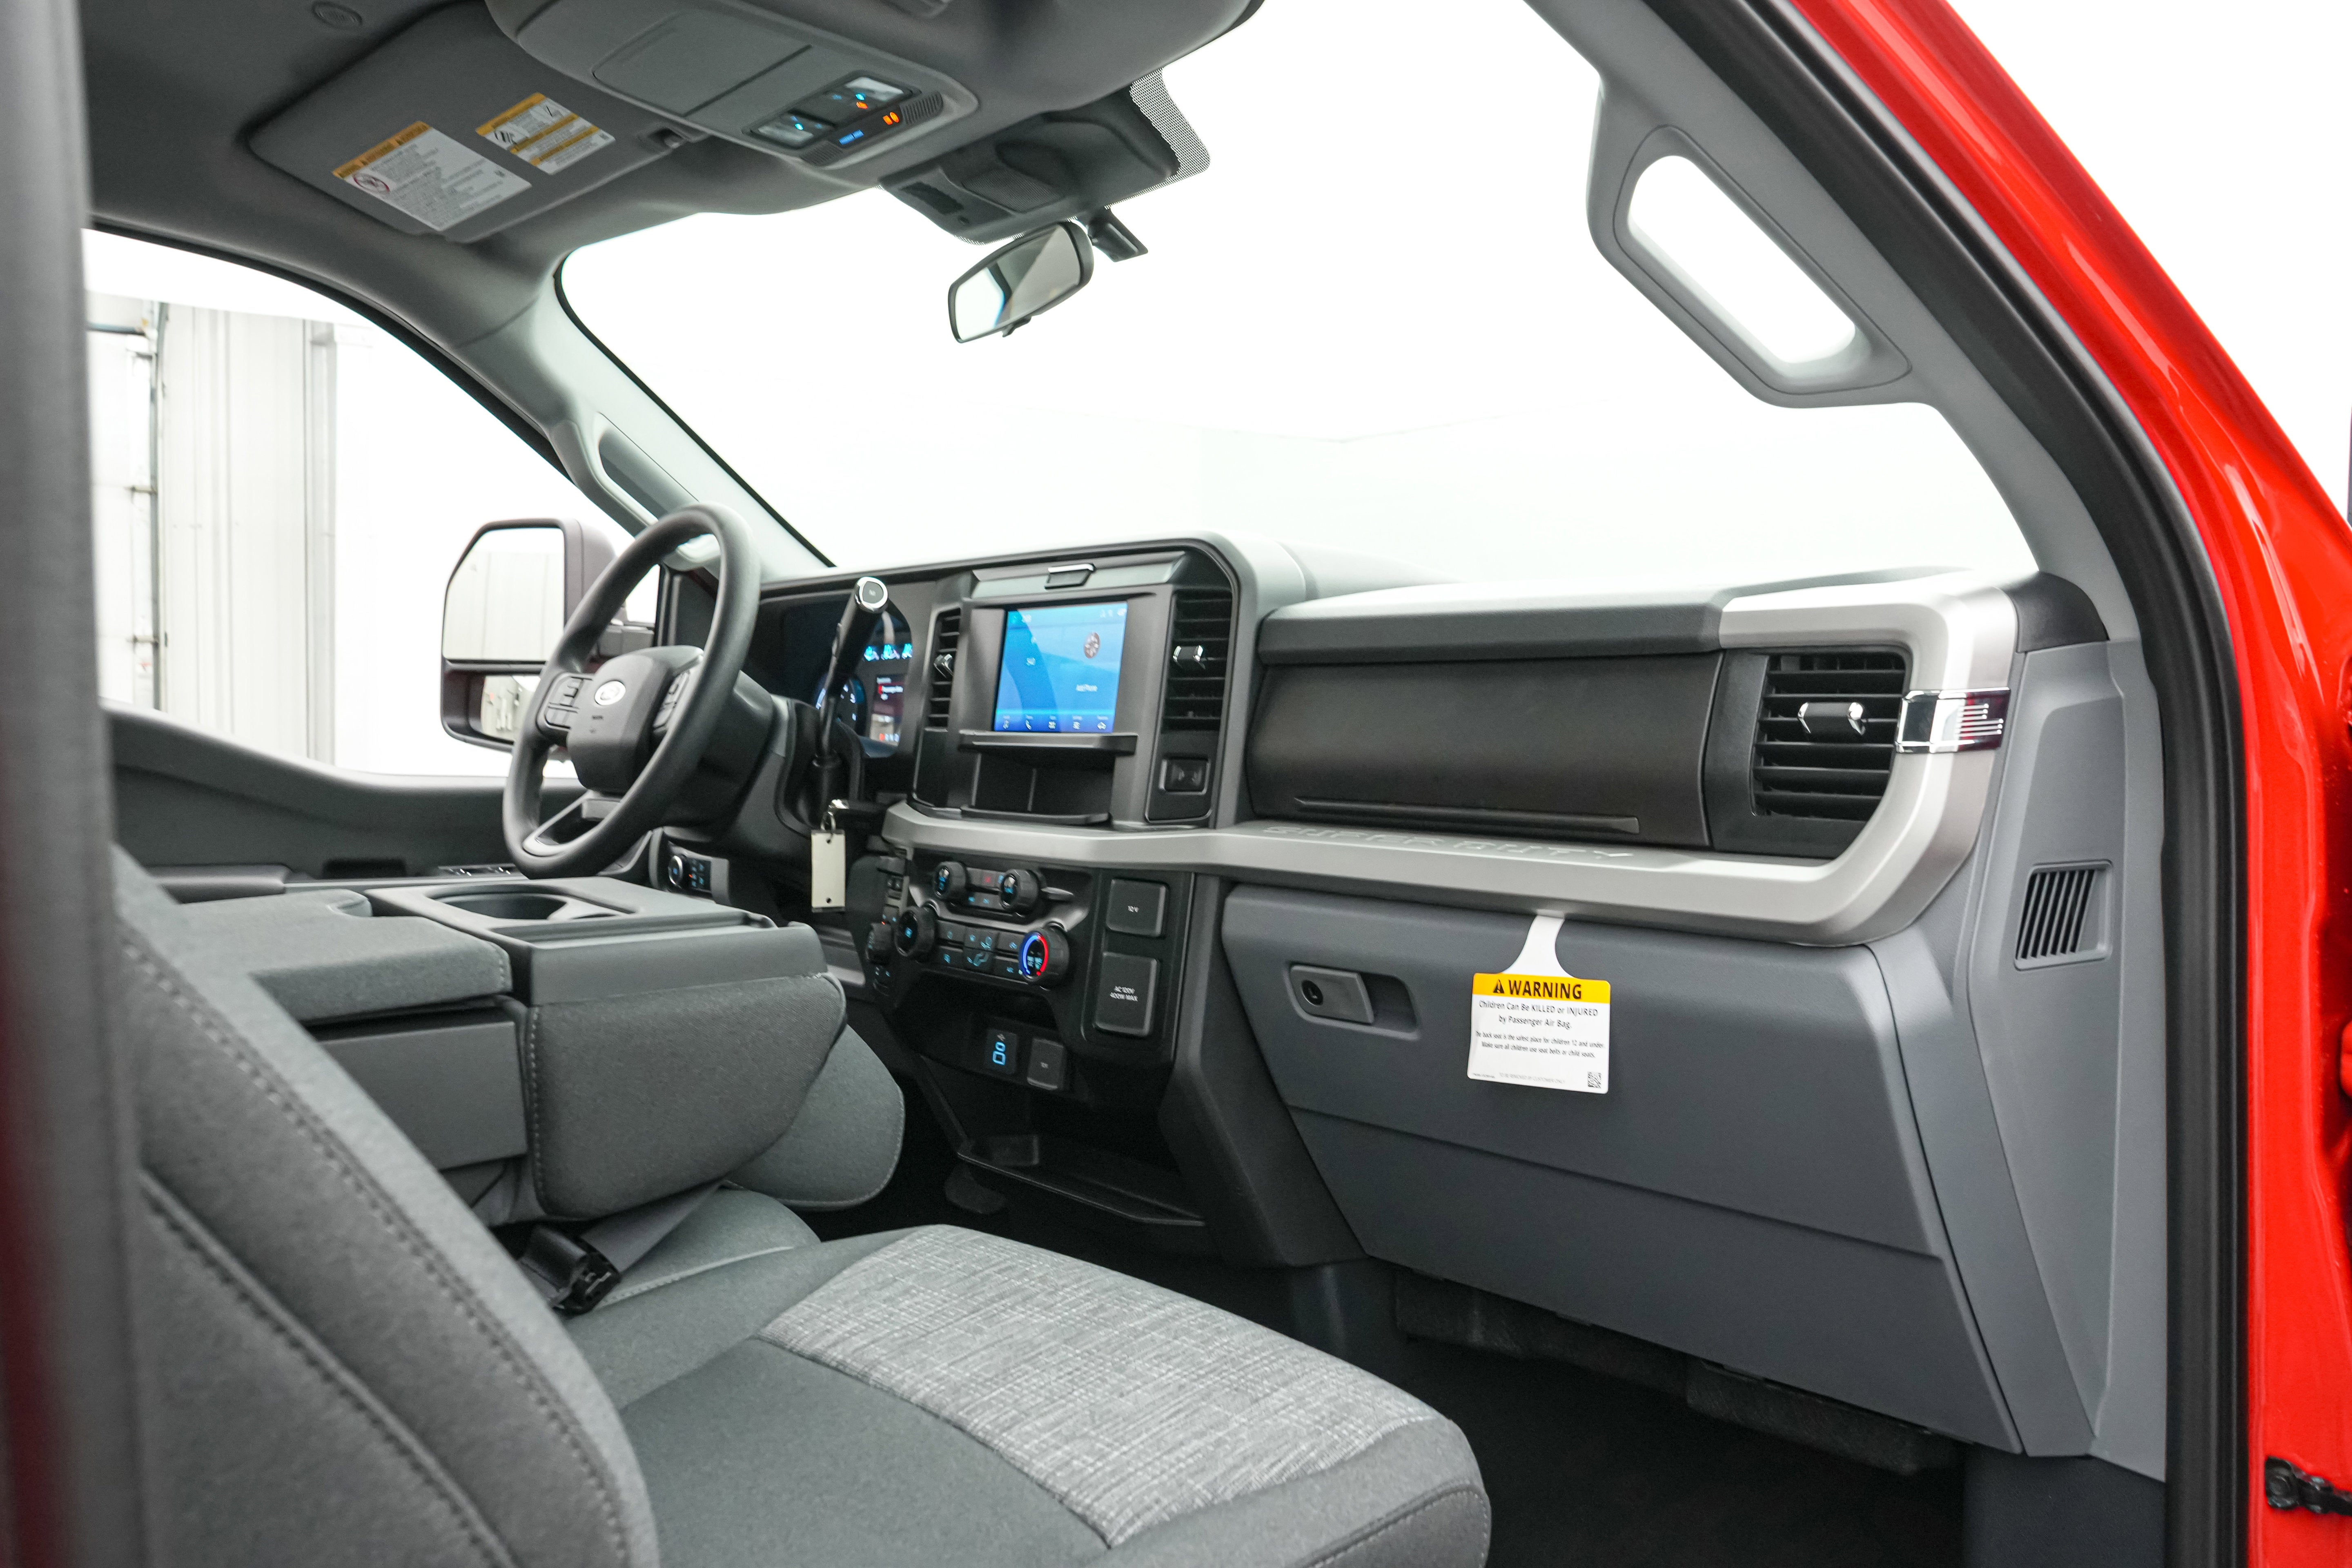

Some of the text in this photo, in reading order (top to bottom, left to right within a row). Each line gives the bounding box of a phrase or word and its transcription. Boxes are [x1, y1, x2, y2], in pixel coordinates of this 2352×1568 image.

[1508, 979, 1582, 1000] WARNING
[1479, 1000, 1505, 1009] Children
[1506, 1002, 1519, 1010] Can
[1521, 1003, 1530, 1011] Be
[1532, 1004, 1555, 1013] KILLED
[1567, 1007, 1598, 1017] INJURED
[1499, 1014, 1506, 1025] by
[1508, 1016, 1542, 1027] Passenger
